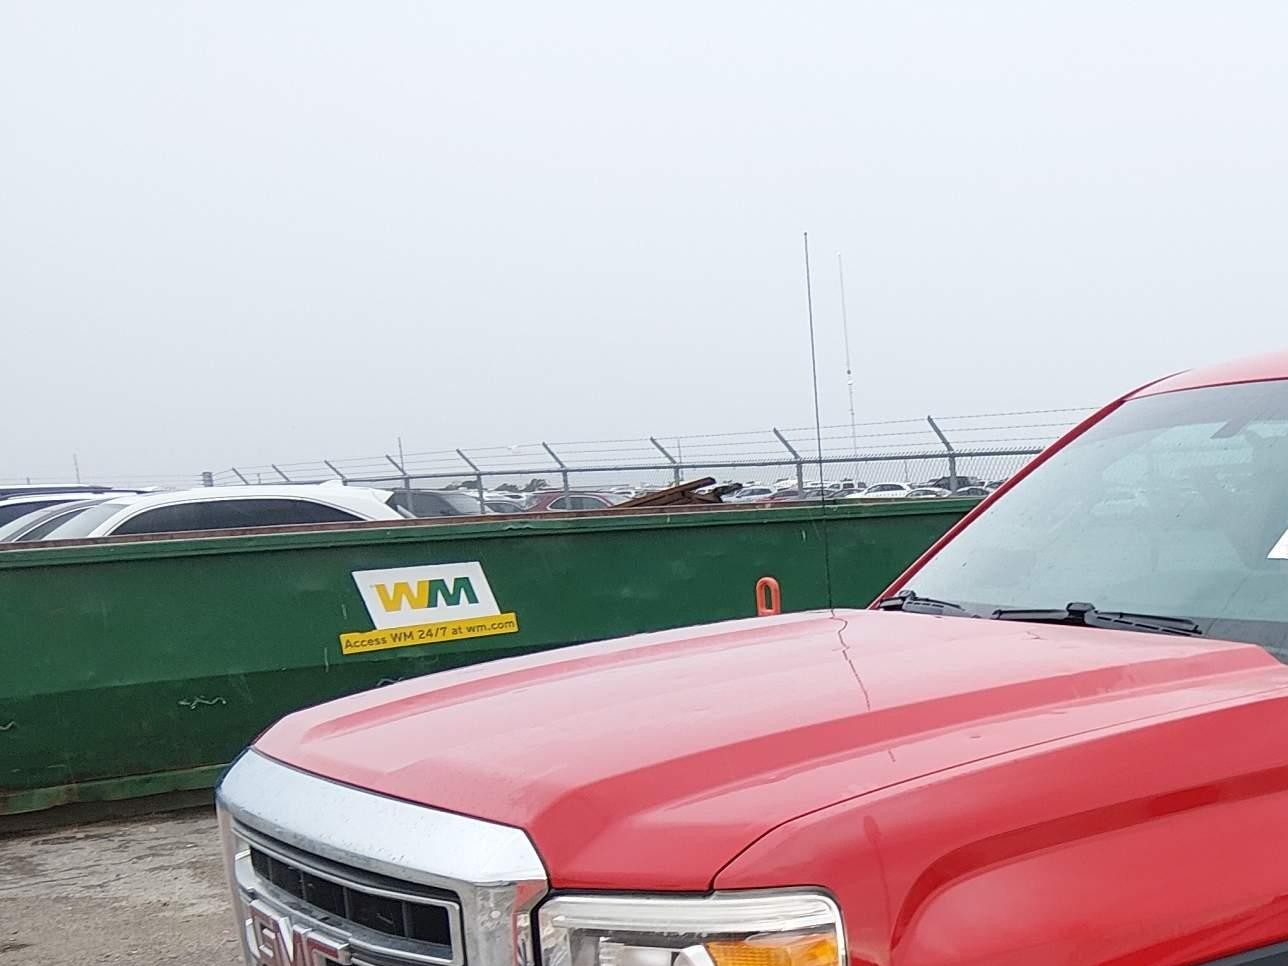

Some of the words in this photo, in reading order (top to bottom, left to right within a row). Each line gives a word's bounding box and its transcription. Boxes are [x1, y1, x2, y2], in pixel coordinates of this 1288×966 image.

[374, 576, 479, 613] WM
[344, 636, 387, 650] Access
[390, 630, 414, 643] WM
[418, 627, 448, 640] 24/7
[451, 626, 463, 636] at
[466, 620, 515, 634] wm.com
